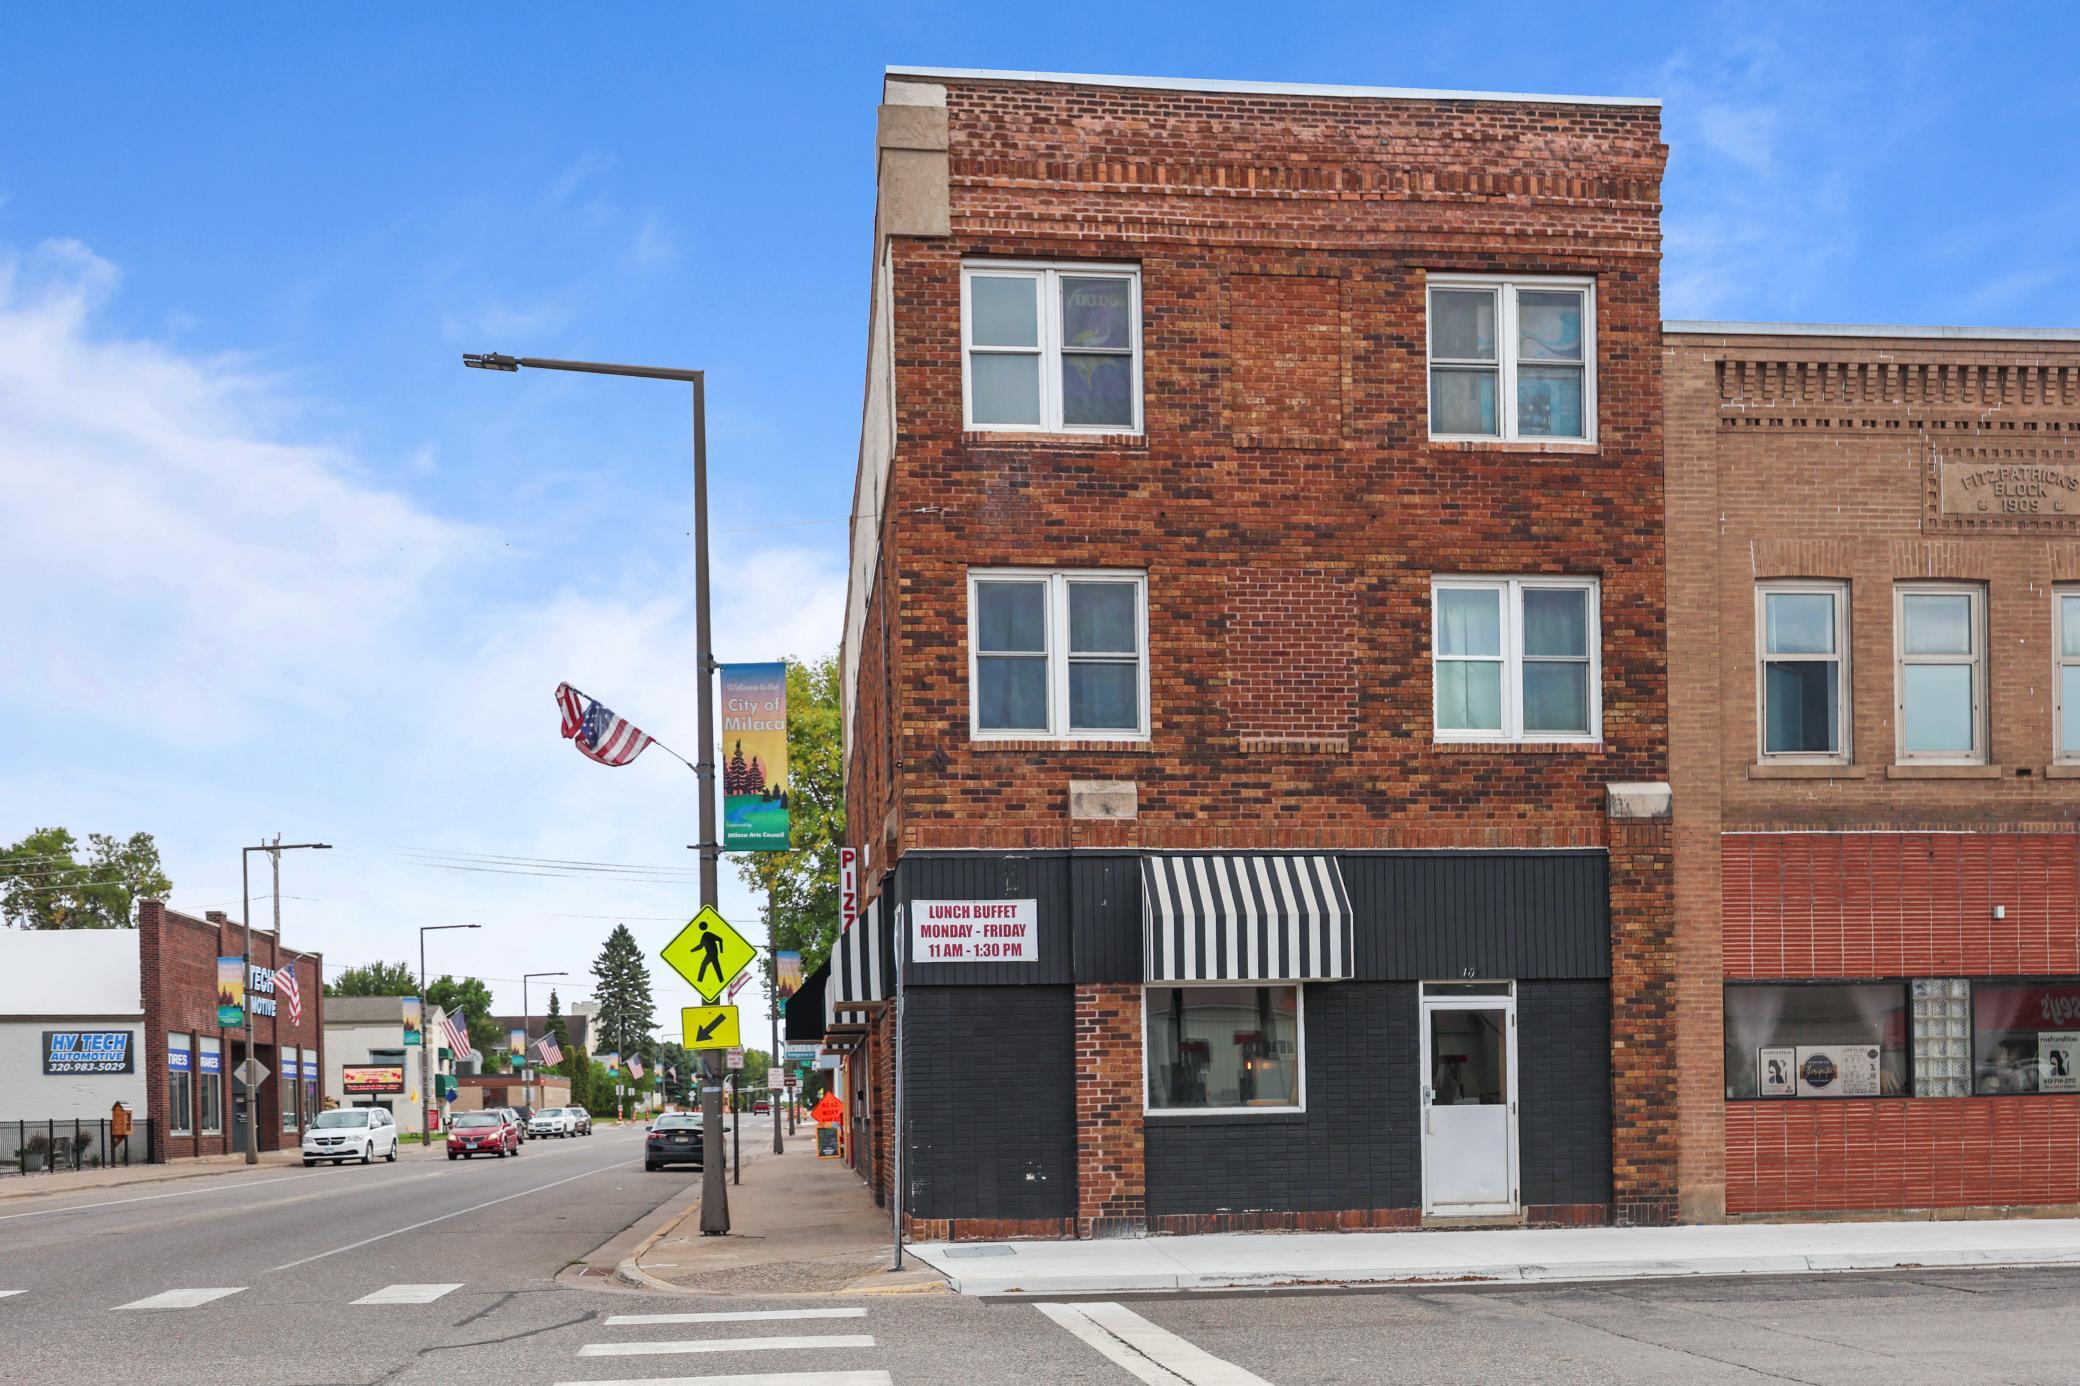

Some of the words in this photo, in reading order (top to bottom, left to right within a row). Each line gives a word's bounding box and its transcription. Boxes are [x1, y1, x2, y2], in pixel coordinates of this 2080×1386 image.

[1961, 467, 2079, 491] FITZPATRICK'S
[1995, 482, 2047, 498] BLOCK
[2002, 499, 2041, 513] 1909
[728, 698, 758, 715] City
[764, 697, 780, 711] of
[724, 716, 785, 731] Milaca
[842, 850, 856, 933] PIZZ
[929, 905, 970, 919] LUNCH
[973, 905, 1017, 919] BUFFET
[920, 924, 973, 938] MONDAY
[983, 924, 1026, 938] FRIDAY
[928, 944, 941, 957] 11
[943, 944, 963, 957] AM
[973, 943, 1000, 957] 1:30
[1003, 943, 1022, 957] PM
[81, 1033, 128, 1051] TECH
[49, 1052, 125, 1062] AUTOMOTIVE
[168, 1053, 188, 1066] TIRES
[49, 1063, 126, 1072] 320-983-5029
